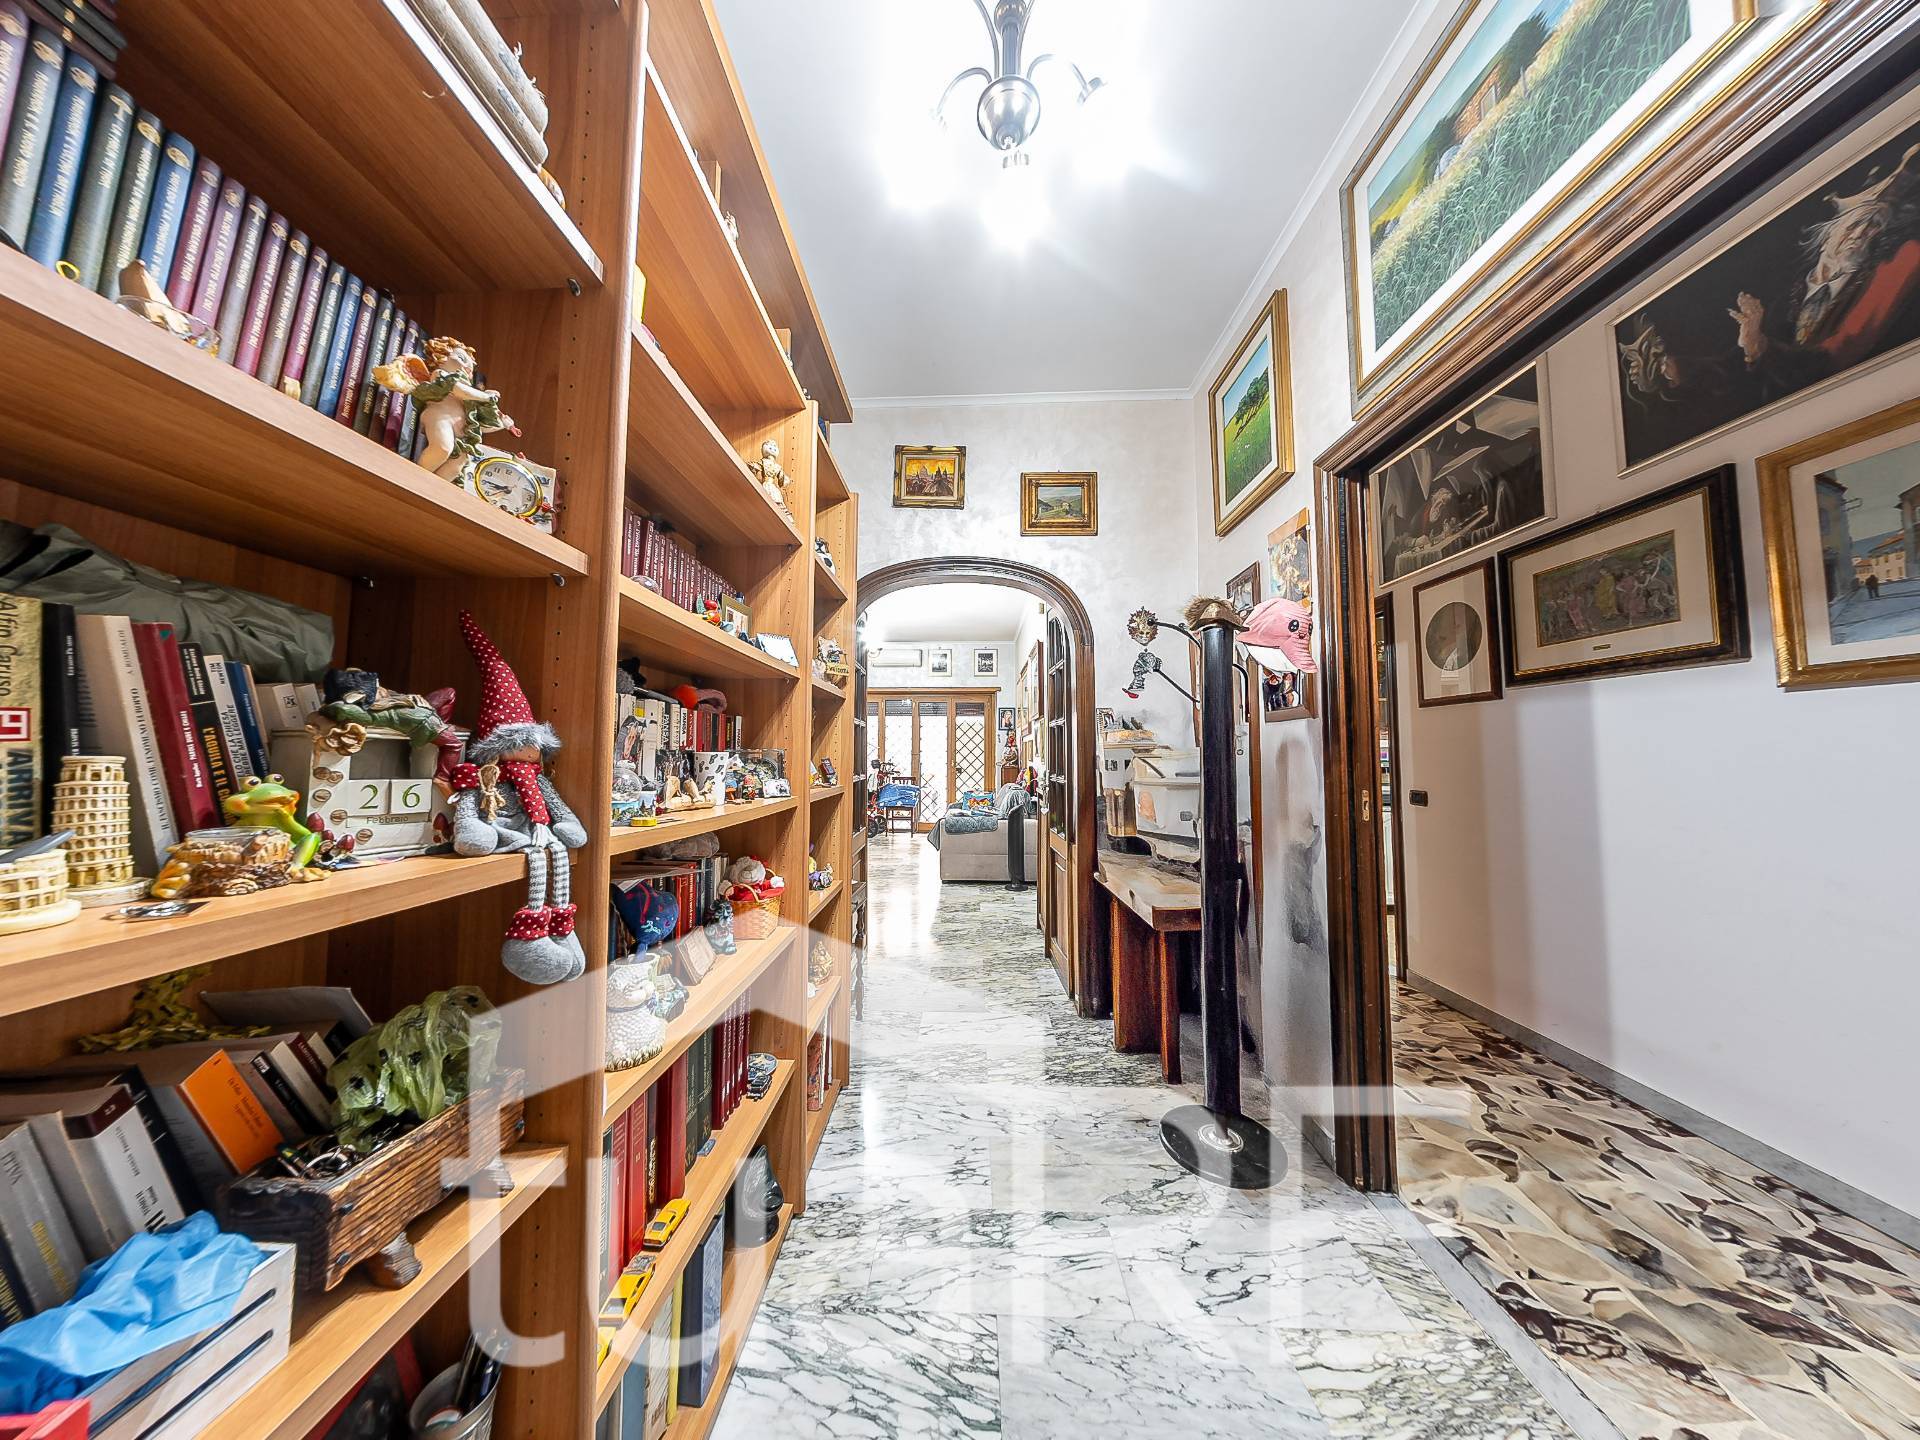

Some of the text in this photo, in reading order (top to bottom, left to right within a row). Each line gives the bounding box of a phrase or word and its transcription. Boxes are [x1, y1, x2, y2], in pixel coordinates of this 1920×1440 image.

[131, 688, 145, 721] EUROPEO
[225, 703, 241, 736] LEGGERE
[219, 711, 234, 737] CHIESA
[663, 714, 672, 743] PANSA
[138, 723, 155, 762] FENOMENO
[202, 727, 224, 768] L'AQUILA
[147, 765, 160, 785] COME
[152, 787, 168, 821] FASCISMO
[360, 784, 421, 809] 2 6
[366, 815, 408, 824] Febbraio
